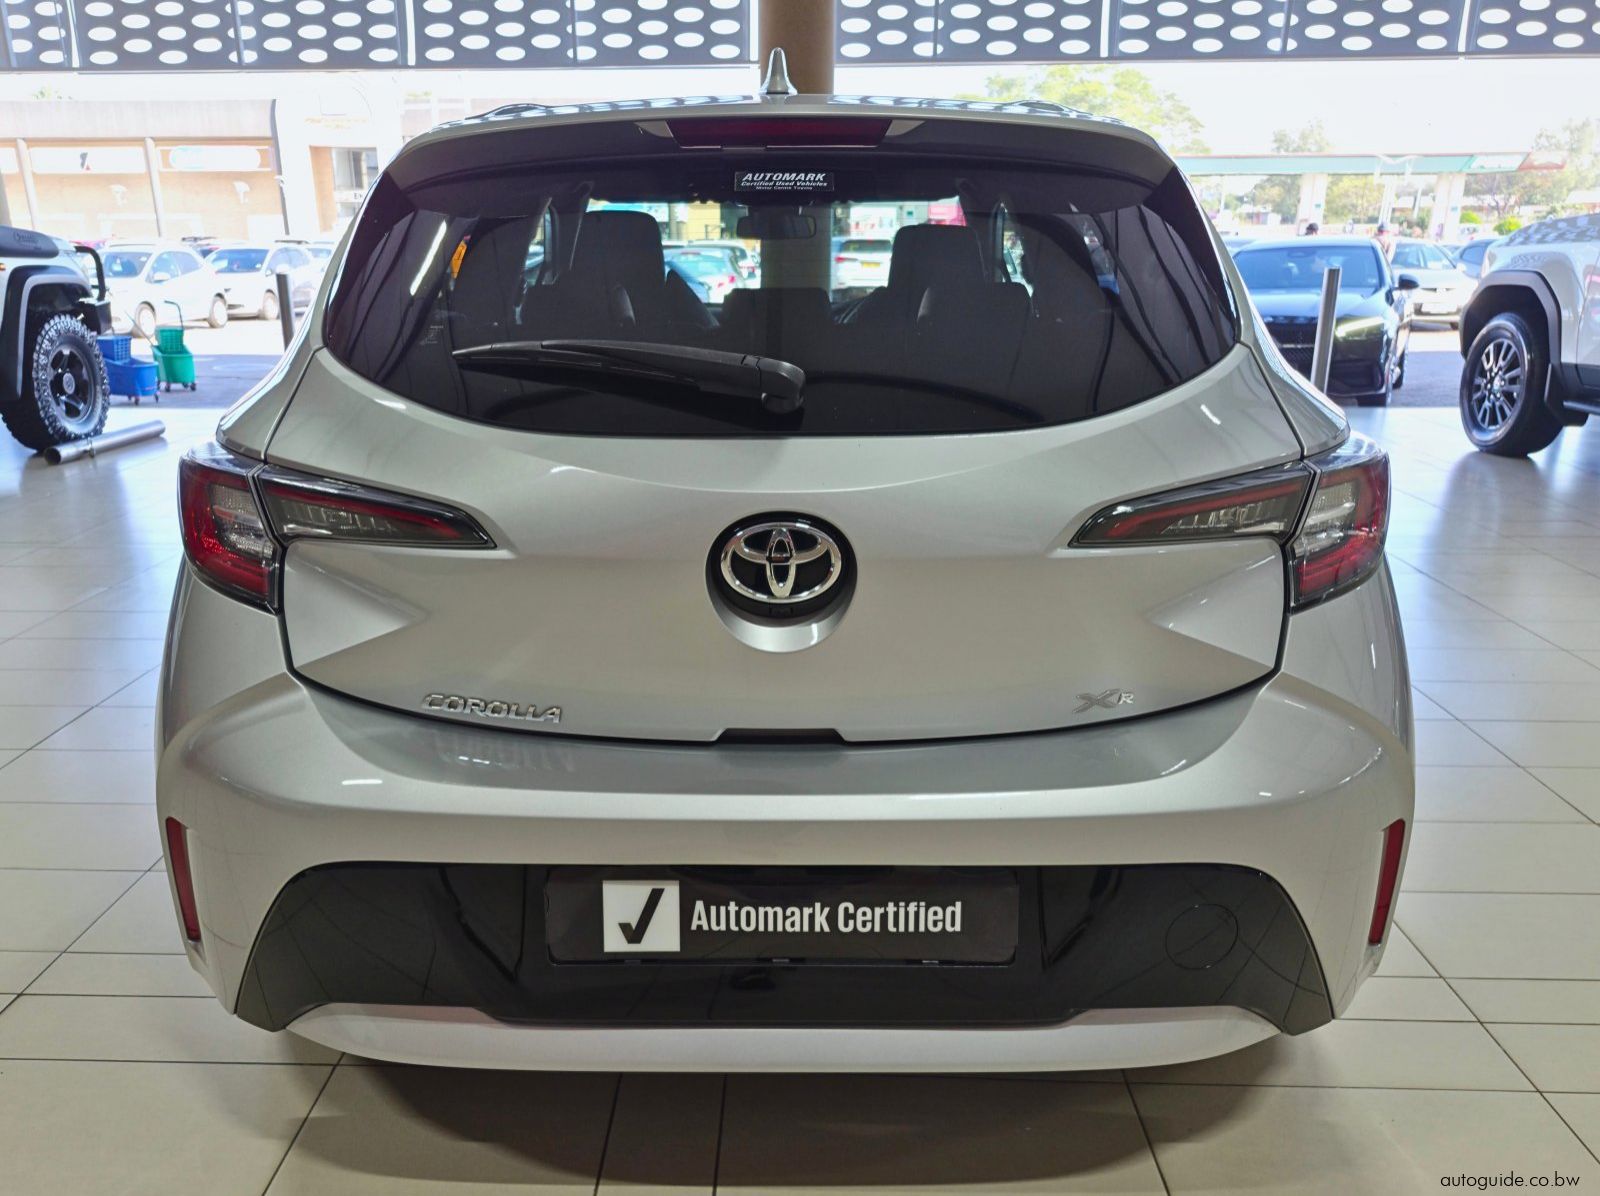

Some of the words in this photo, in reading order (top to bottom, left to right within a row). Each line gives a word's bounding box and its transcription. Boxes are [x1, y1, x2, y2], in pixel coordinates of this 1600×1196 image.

[742, 172, 826, 181] AUTOMARK
[421, 693, 562, 724] COROLLA
[690, 900, 831, 933] Automark
[837, 900, 962, 933] Certified
